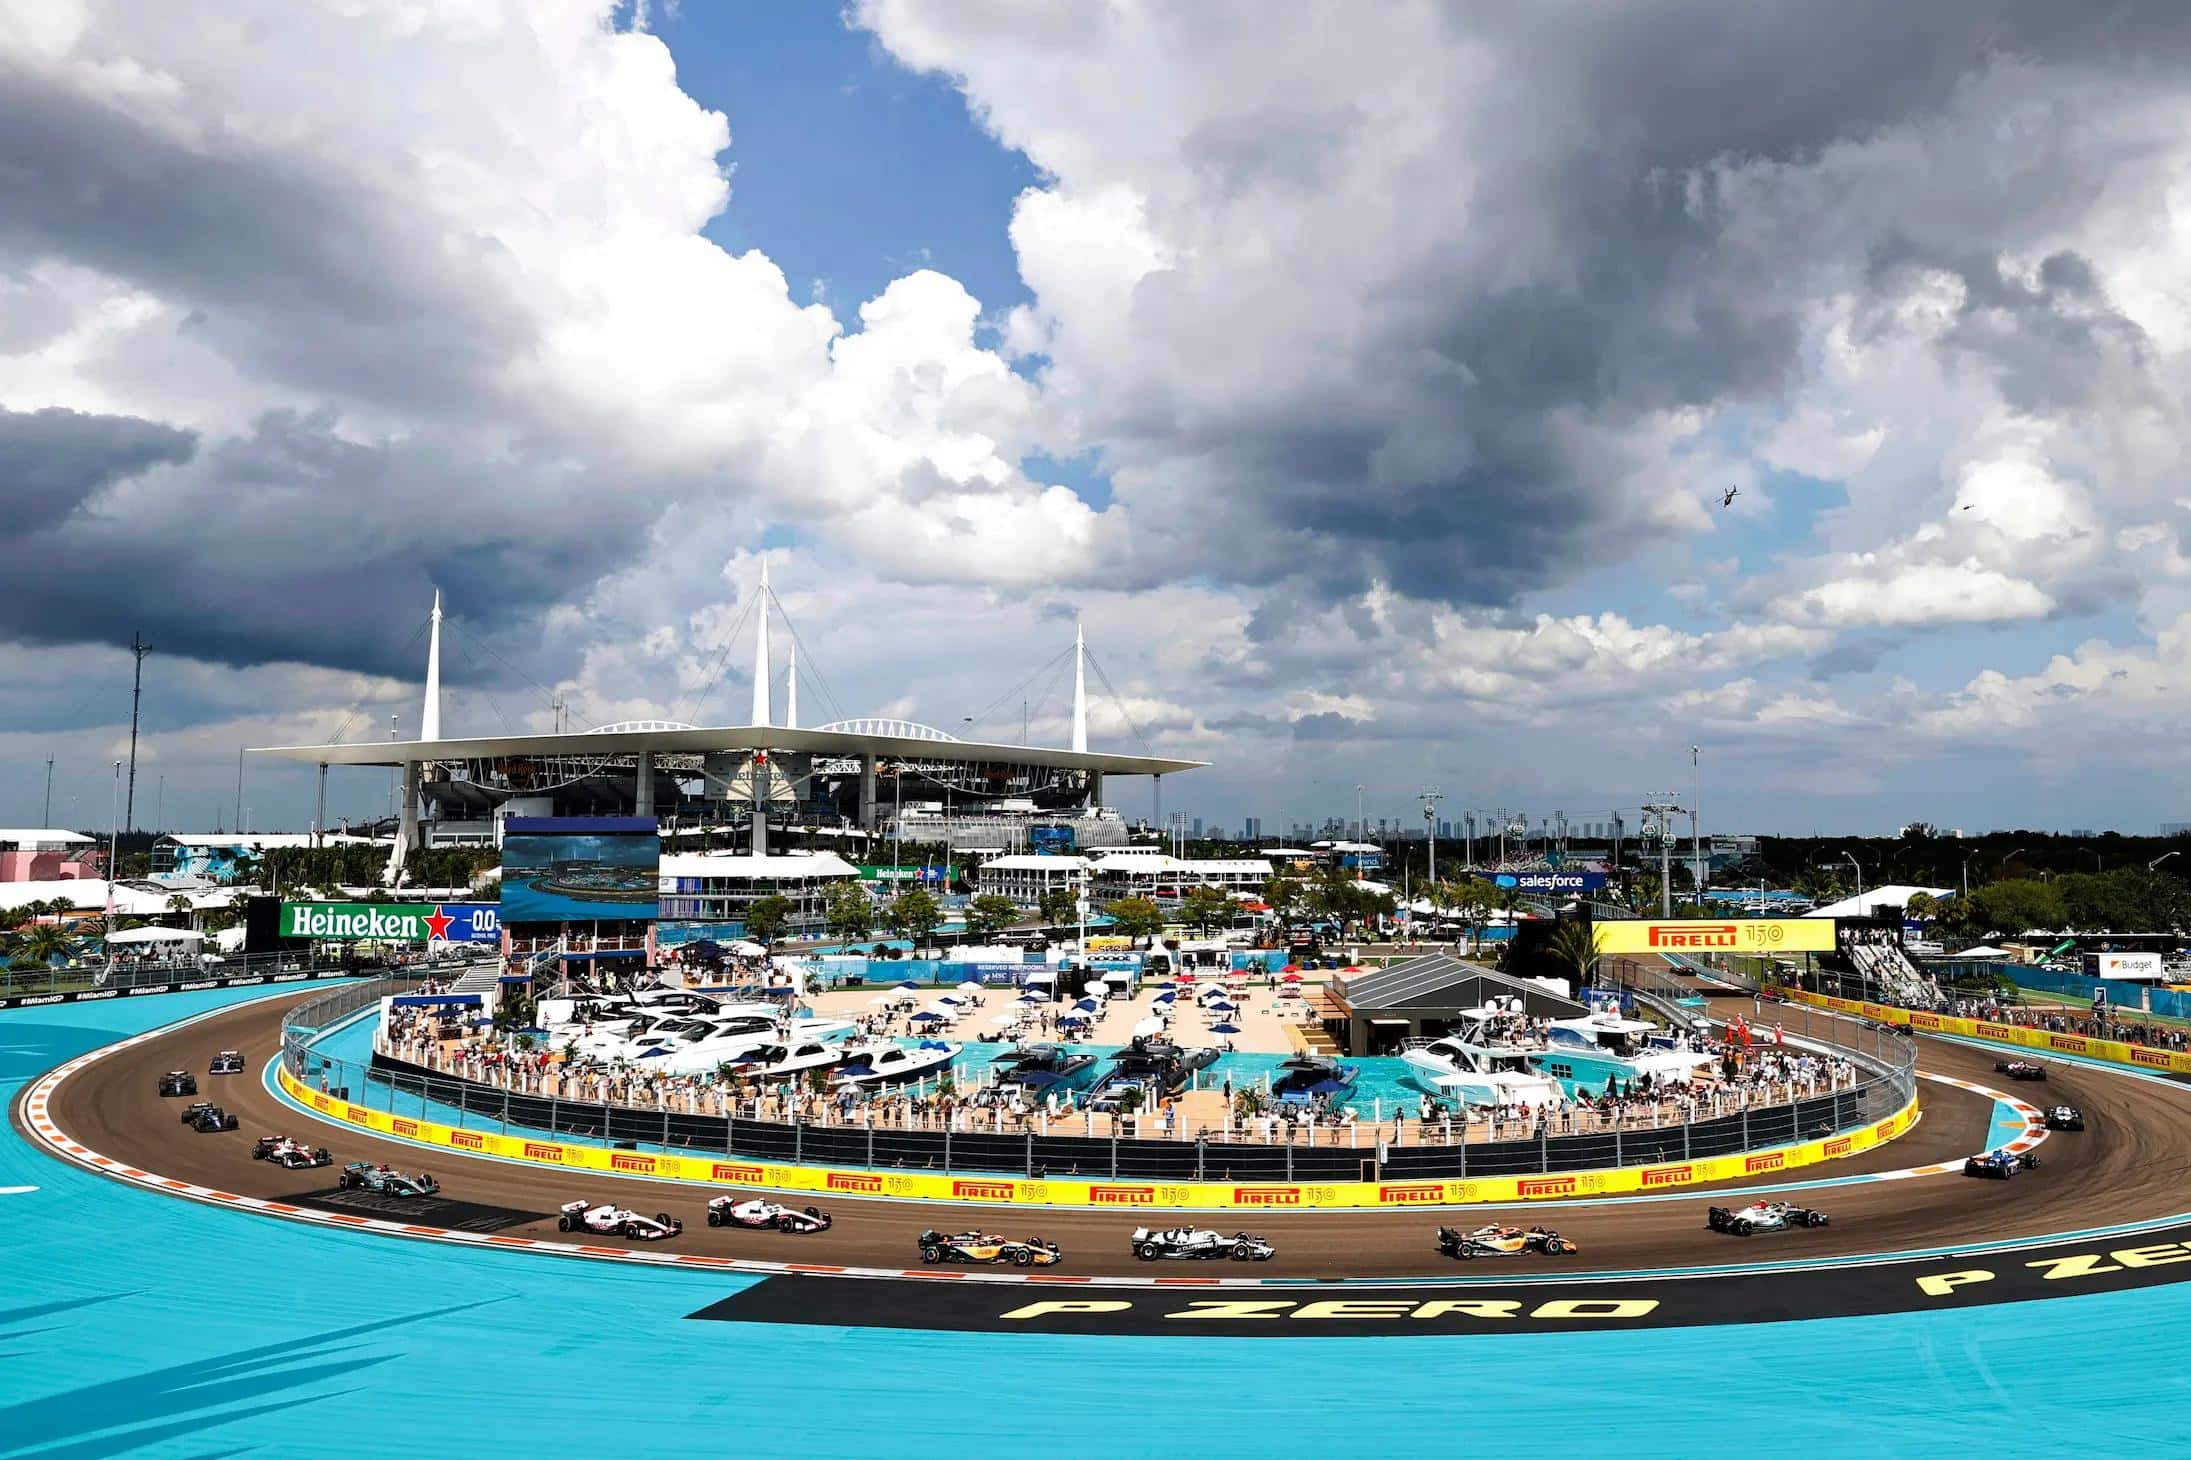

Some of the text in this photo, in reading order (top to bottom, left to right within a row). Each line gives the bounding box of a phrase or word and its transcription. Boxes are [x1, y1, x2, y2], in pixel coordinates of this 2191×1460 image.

[1520, 874, 1584, 890] salesforce
[291, 906, 496, 938] Heineken 0.0
[1648, 925, 1737, 947] PIRELLI
[2121, 960, 2152, 972] Budget
[128, 985, 169, 995] #MiamiGP
[1976, 1023, 2009, 1039] PIRELLI
[2050, 1035, 2086, 1052] PIRELLI
[2130, 1048, 2171, 1067] PIRELLI
[393, 1119, 417, 1137] PIRELLI
[452, 1131, 483, 1149] PIRELLI
[1823, 1137, 1851, 1157] PIRELLI
[524, 1143, 562, 1161] PIRELLI
[611, 1154, 656, 1173] PIRELLI
[1745, 1152, 1784, 1172] PIRELLI
[712, 1164, 764, 1182] PIRELLI
[1642, 1166, 1692, 1185] PIRELLI
[827, 1173, 882, 1192] PIRELLI
[952, 1181, 1014, 1199] PIRELLI
[1517, 1177, 1576, 1196] PIRELLI
[1089, 1186, 1155, 1203] PIRELLI
[1234, 1188, 1300, 1204] PIRELLI
[1379, 1185, 1444, 1202] PIRELLI
[1915, 1240, 2191, 1296] P ZE
[999, 1299, 1660, 1319] P ZERO
